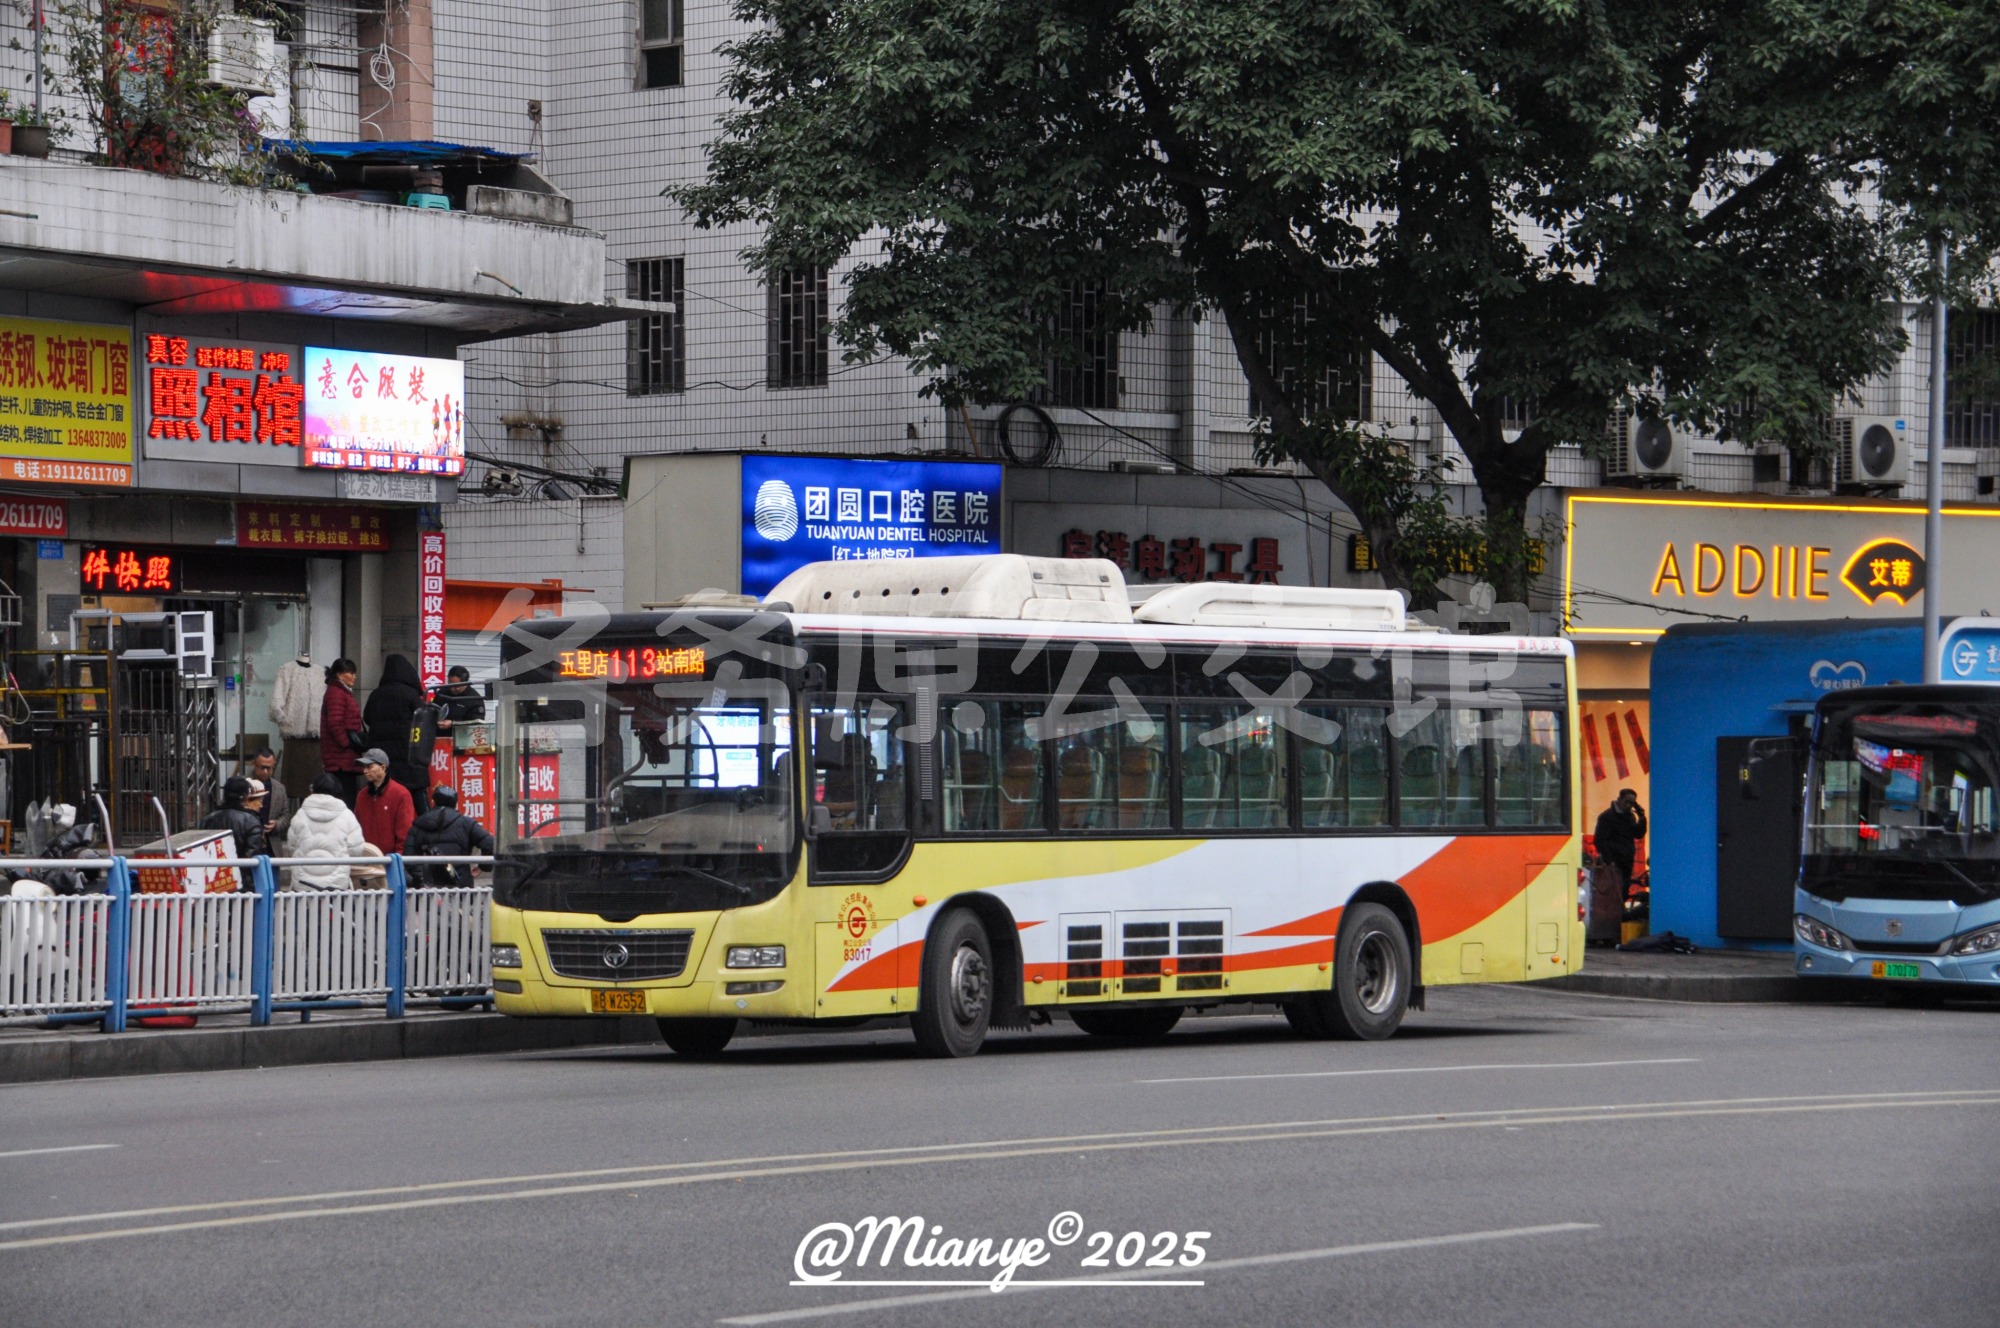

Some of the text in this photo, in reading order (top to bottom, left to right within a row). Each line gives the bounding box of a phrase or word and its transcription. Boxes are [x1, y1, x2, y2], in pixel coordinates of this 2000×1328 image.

[147, 334, 188, 365] 真容
[260, 352, 290, 372] 冲印
[318, 357, 429, 405] 意合服装
[149, 368, 303, 446] 照相馆
[68, 429, 127, 450] 13648373009
[804, 485, 989, 525] 团圆口腔医院
[806, 525, 989, 544] TUANYUAN DENTEL HOSPITAL
[82, 549, 171, 592] 件快照
[1869, 558, 1912, 588] 艾蒂
[1518, 639, 1561, 651] 重庆公交
[1986, 643, 2000, 664] 重
[560, 648, 705, 678] 五里店 113 站南路
[844, 948, 872, 961] 83017
